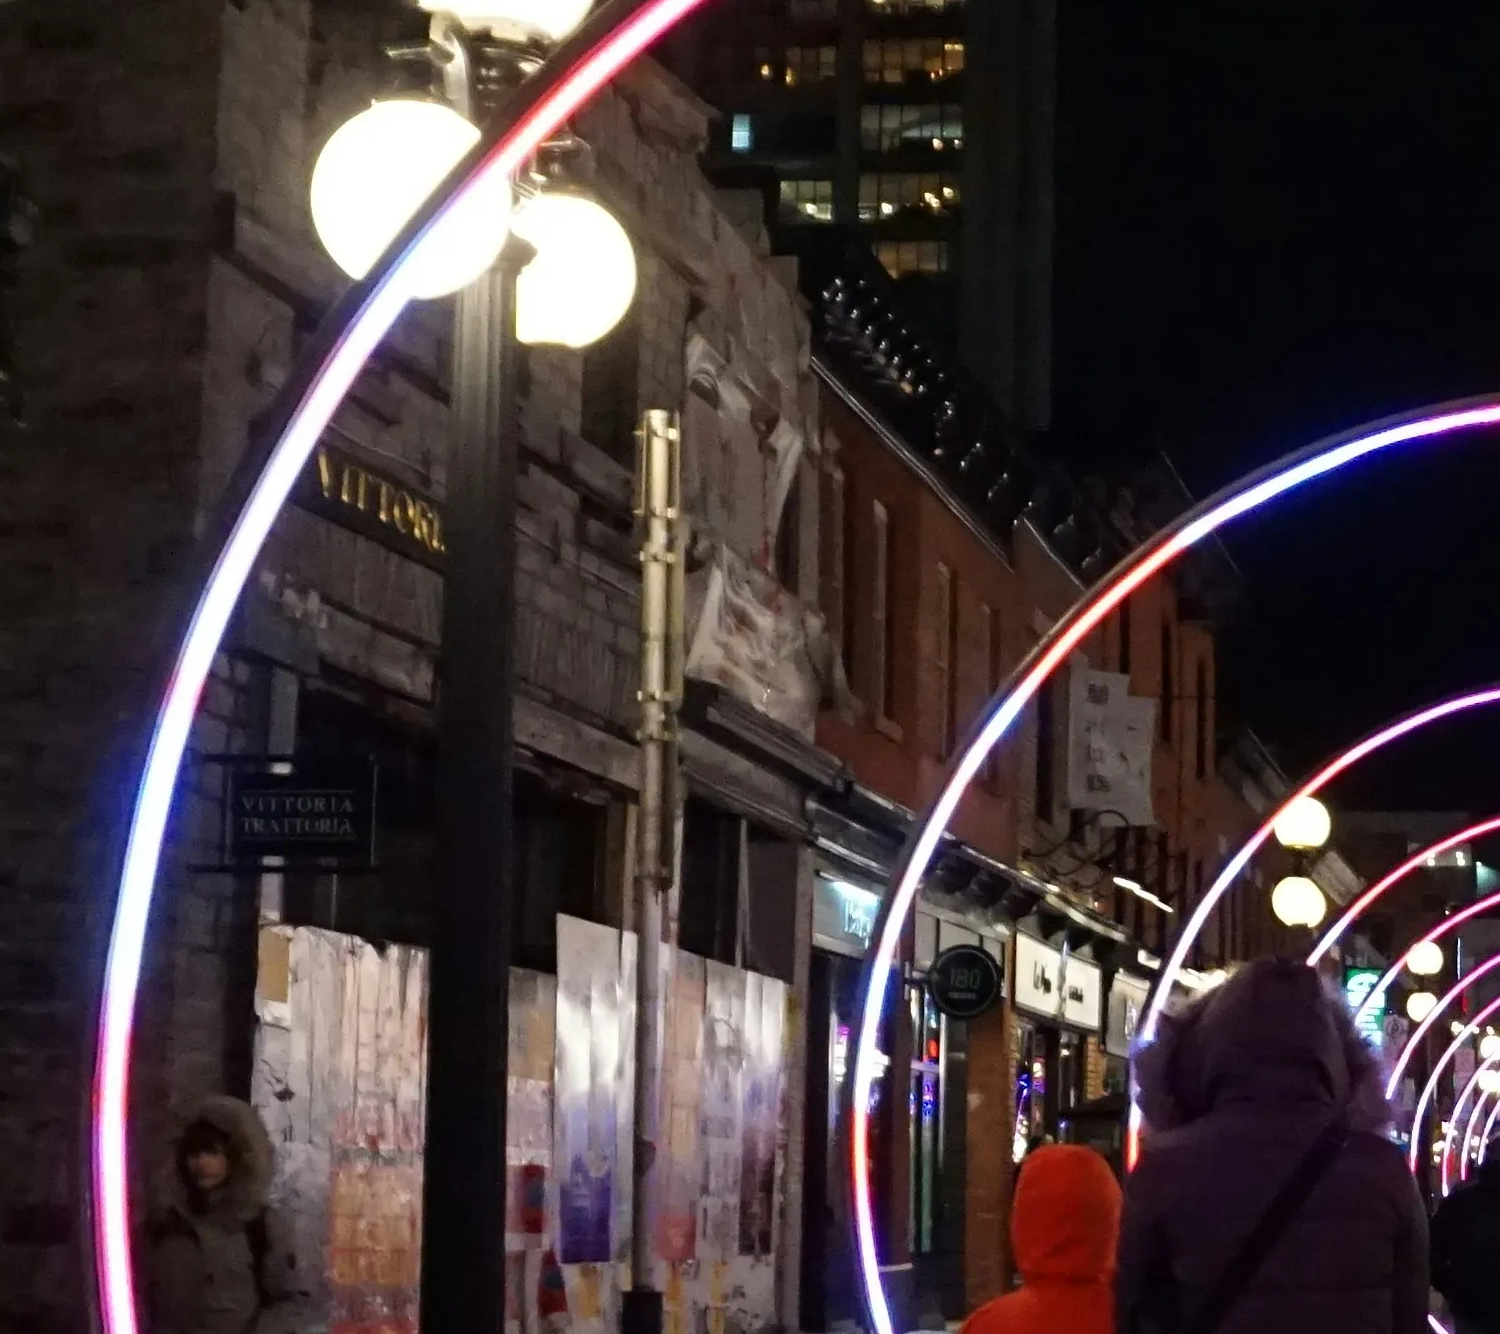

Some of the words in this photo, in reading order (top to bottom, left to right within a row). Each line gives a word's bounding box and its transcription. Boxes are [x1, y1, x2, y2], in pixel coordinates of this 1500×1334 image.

[317, 445, 446, 554] VITTORI
[241, 795, 355, 814] VITTORIA
[240, 817, 354, 835] TRATTORIA
